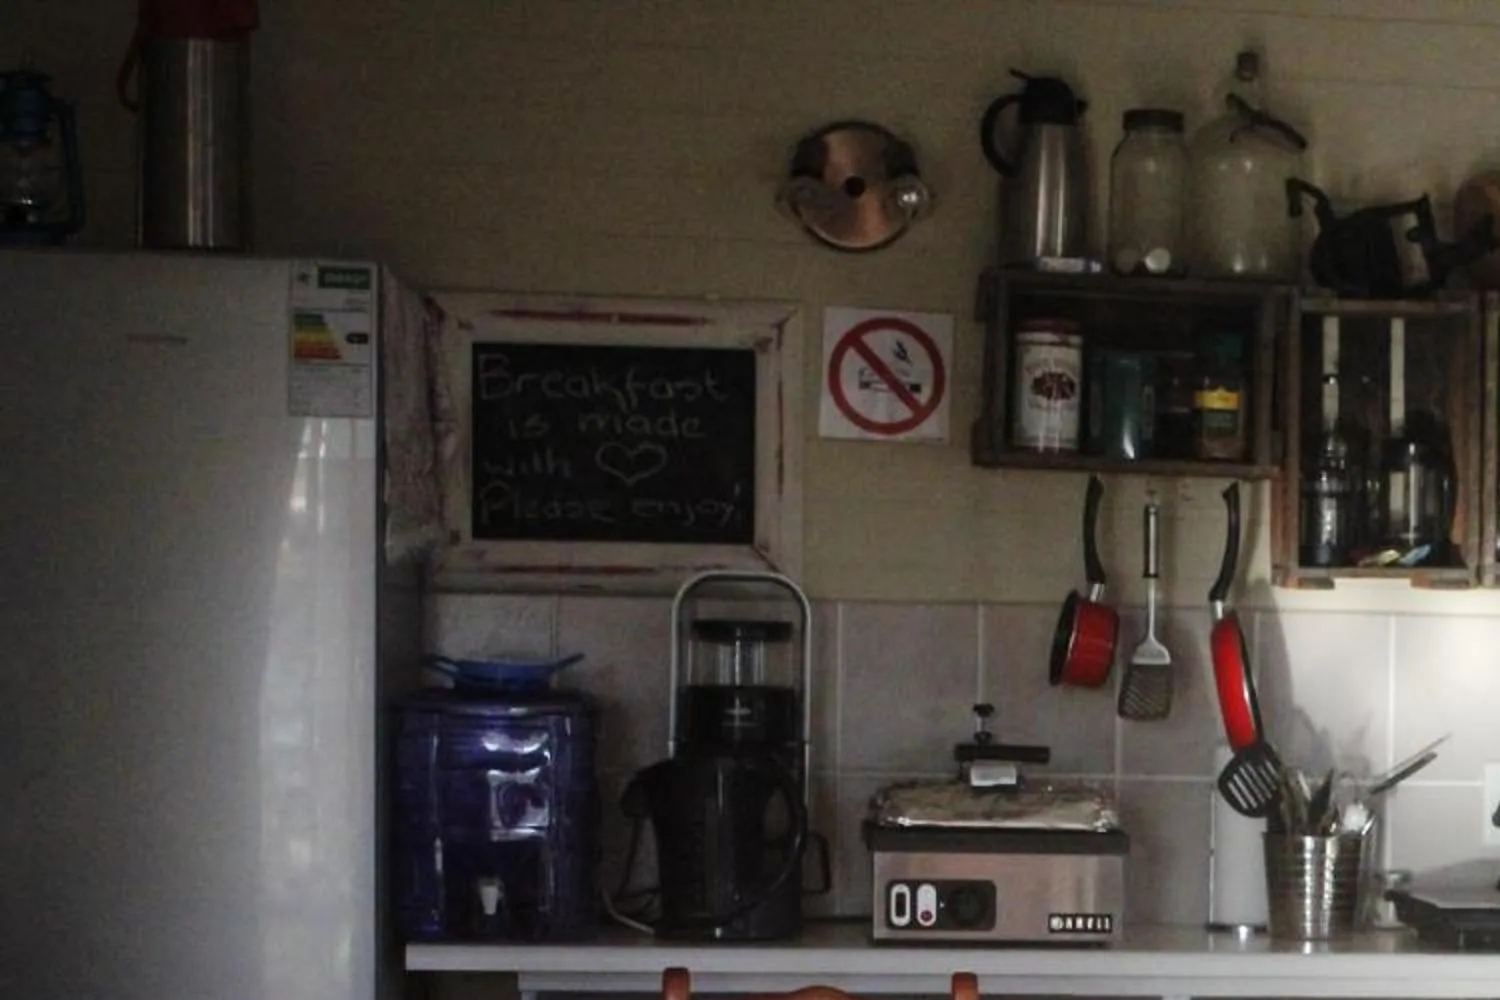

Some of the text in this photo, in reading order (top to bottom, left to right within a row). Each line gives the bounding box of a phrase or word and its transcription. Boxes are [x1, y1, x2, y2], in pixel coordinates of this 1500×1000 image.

[479, 352, 728, 412] Breakfast
[577, 408, 706, 439] made
[483, 445, 572, 478] with
[479, 479, 616, 526] Please
